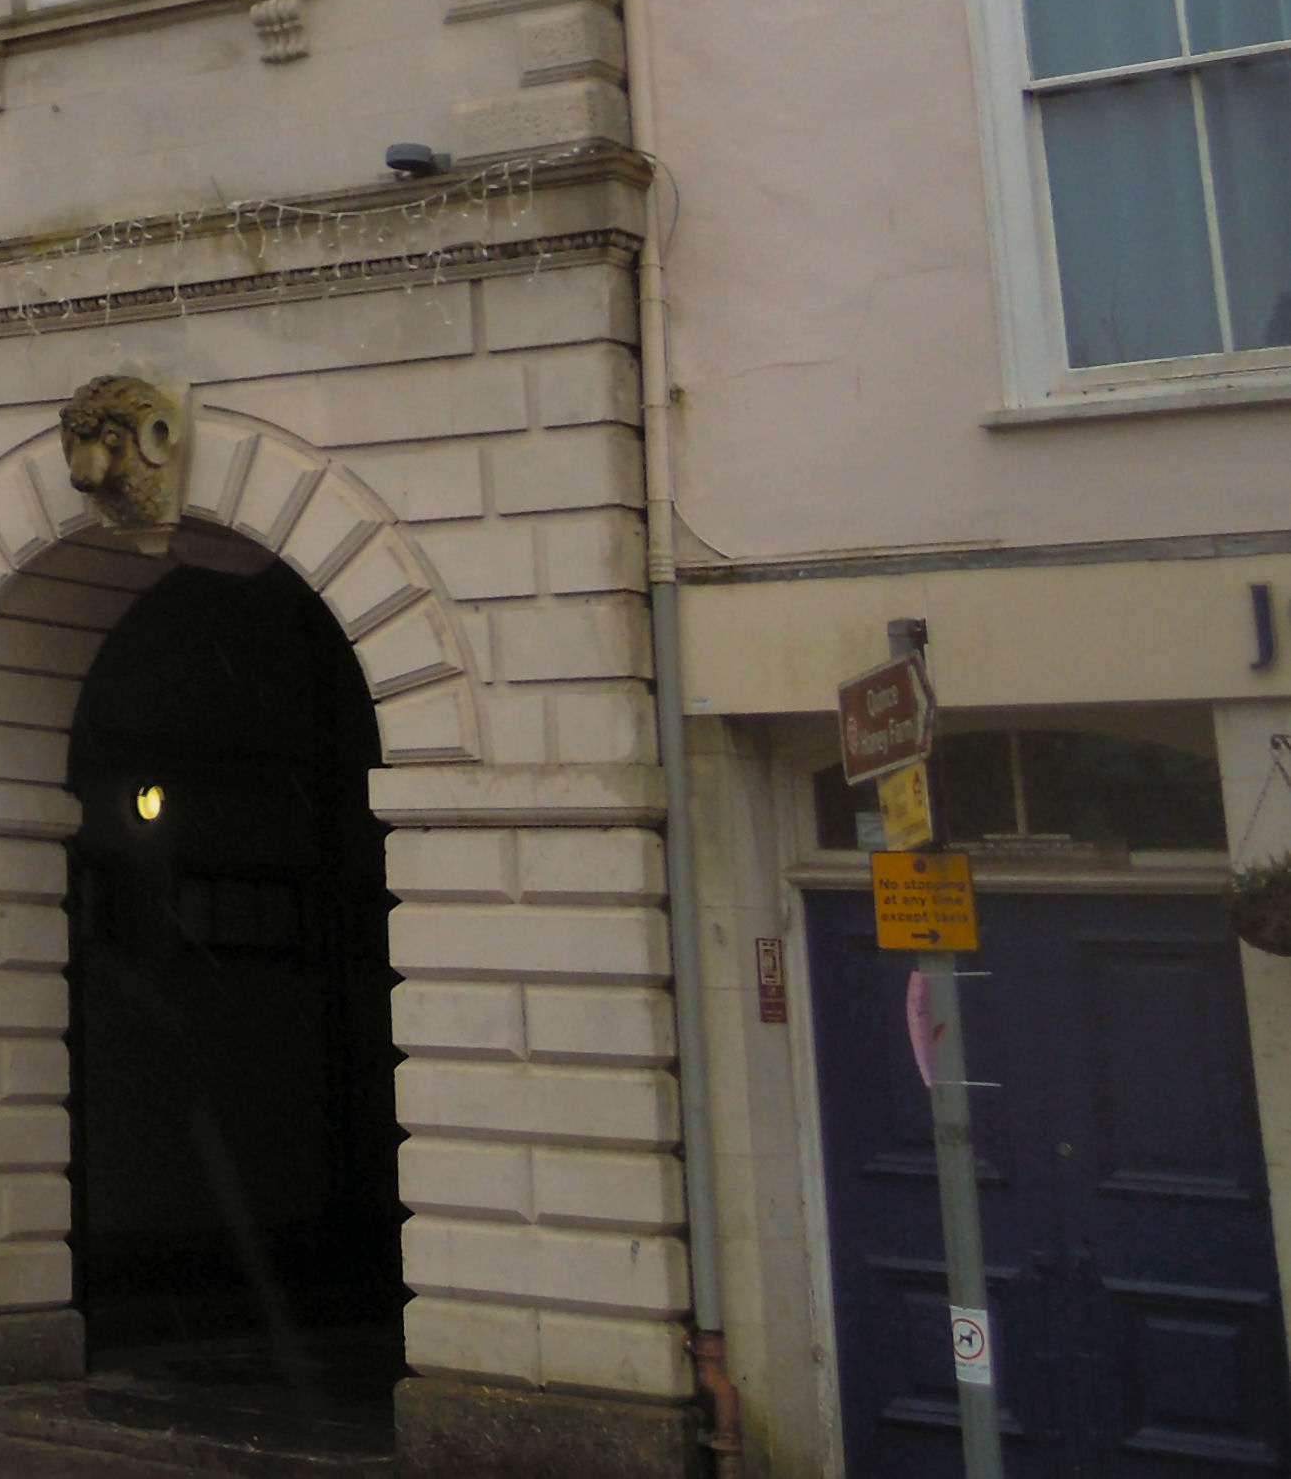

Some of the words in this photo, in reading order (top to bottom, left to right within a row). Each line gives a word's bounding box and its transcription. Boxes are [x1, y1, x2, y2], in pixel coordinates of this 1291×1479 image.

[867, 685, 898, 717] Quince
[888, 717, 916, 747] Farm
[878, 878, 899, 890] No
[904, 880, 965, 893] stopping
[884, 895, 898, 905] at
[903, 896, 926, 907] any
[933, 894, 964, 906] time
[880, 912, 929, 923] except
[933, 911, 969, 924] taxis
